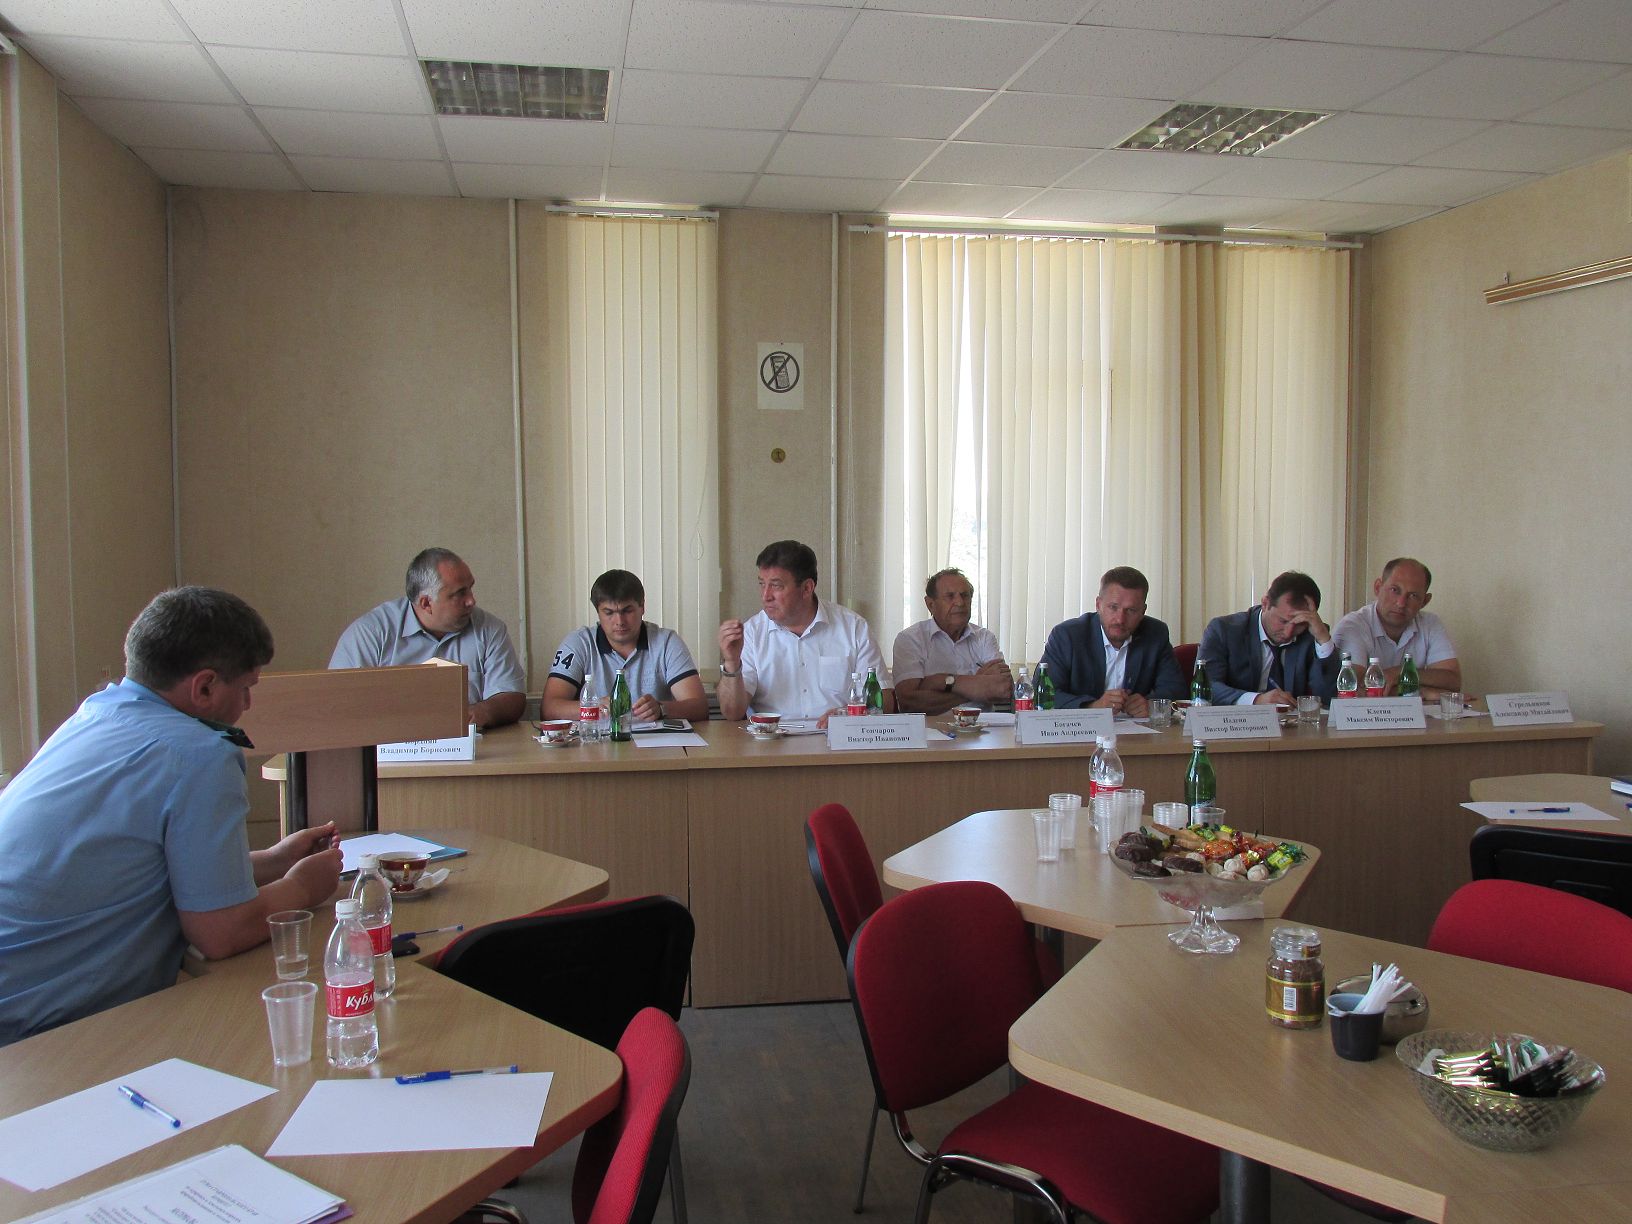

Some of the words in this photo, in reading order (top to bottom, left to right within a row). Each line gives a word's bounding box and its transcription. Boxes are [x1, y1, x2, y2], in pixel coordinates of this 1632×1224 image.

[552, 650, 575, 670] 54
[861, 727, 895, 735] Гончаров
[380, 747, 418, 755] Владимир
[420, 746, 461, 754] Борисович
